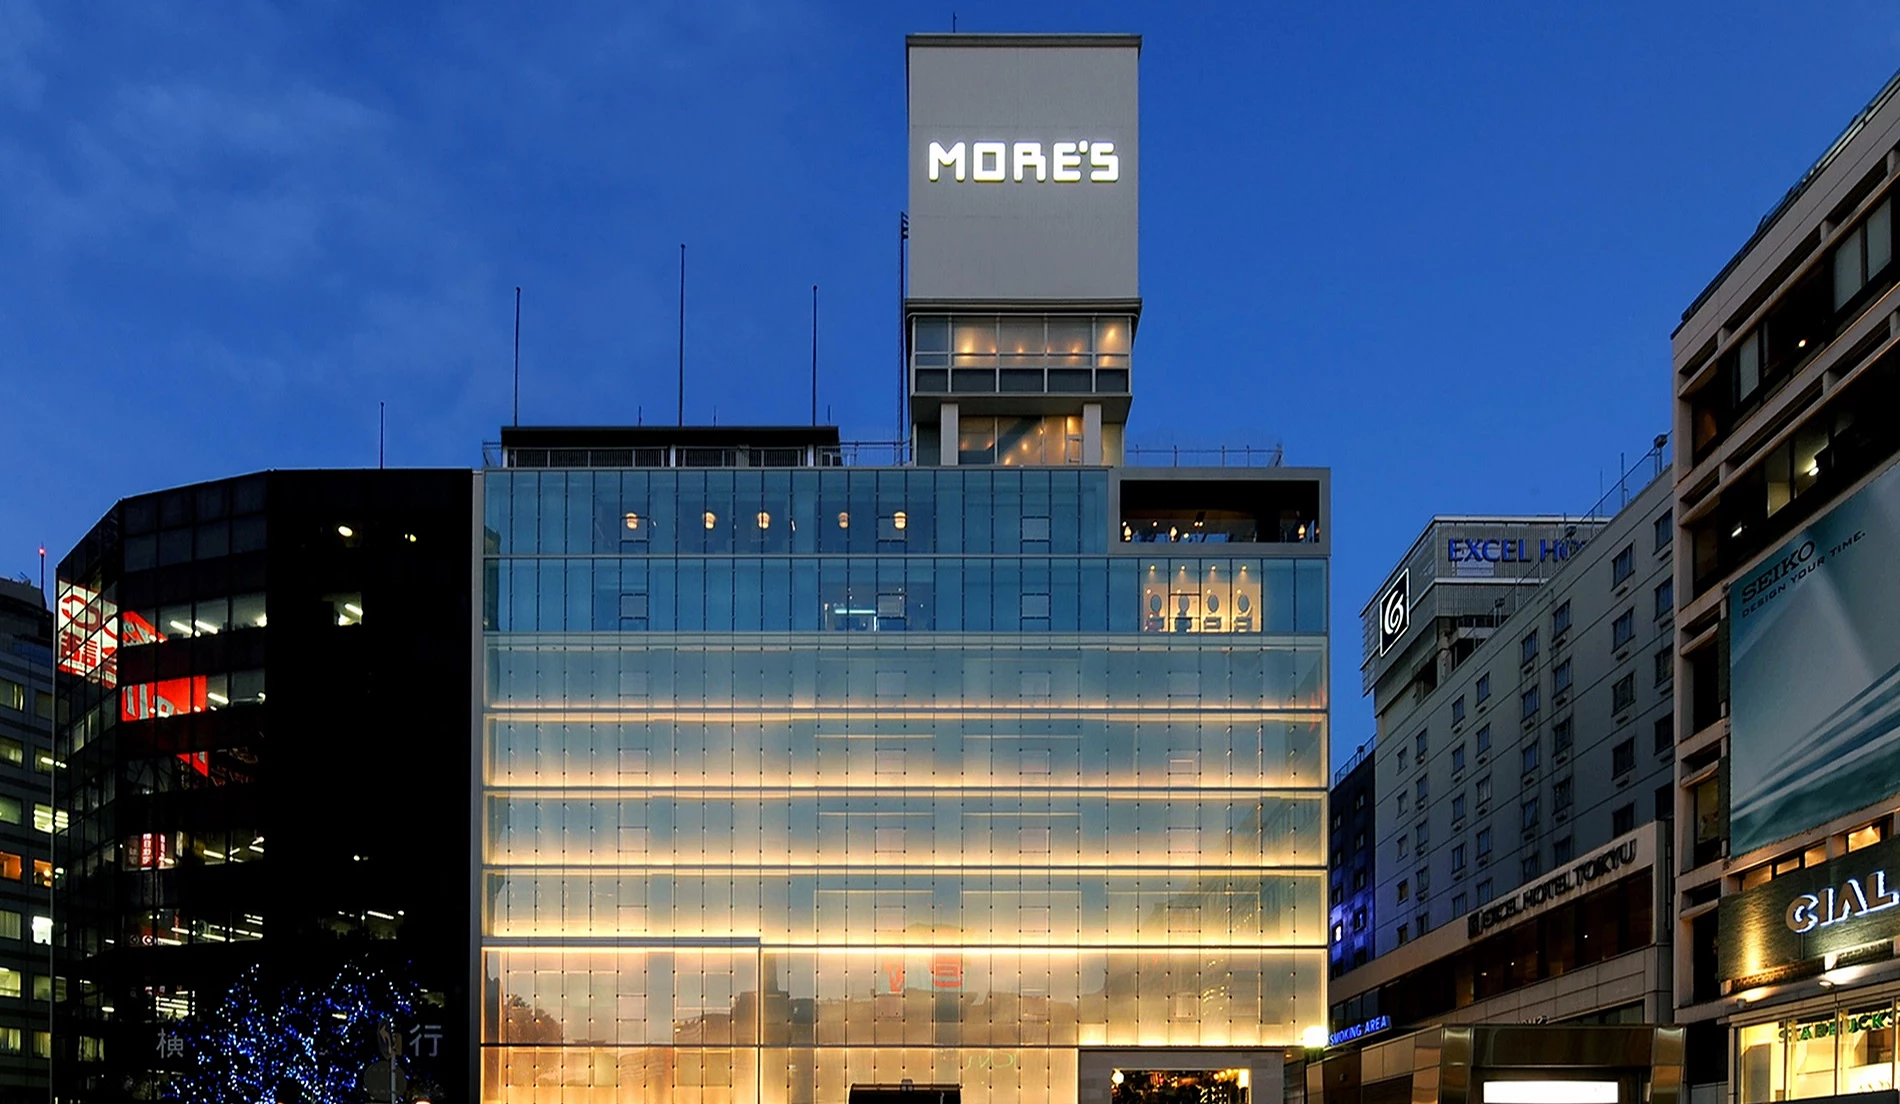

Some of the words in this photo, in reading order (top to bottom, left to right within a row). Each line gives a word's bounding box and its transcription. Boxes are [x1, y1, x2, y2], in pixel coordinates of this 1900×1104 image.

[928, 140, 1119, 183] MORE'S
[1448, 537, 1531, 562] EXCEL
[1540, 538, 1586, 562] HO
[1742, 540, 1815, 604] SEIKO
[1742, 583, 1786, 619] DESIGN
[1790, 555, 1825, 583] YOUR
[1828, 530, 1866, 558] TIME.
[1482, 894, 1524, 929] EXCEL
[1522, 871, 1575, 910] HOTEL
[1573, 838, 1638, 886] TOKYU
[1785, 867, 1900, 933] CIAL
[1329, 1023, 1363, 1046] SMOKING
[1364, 1015, 1388, 1034] AREA
